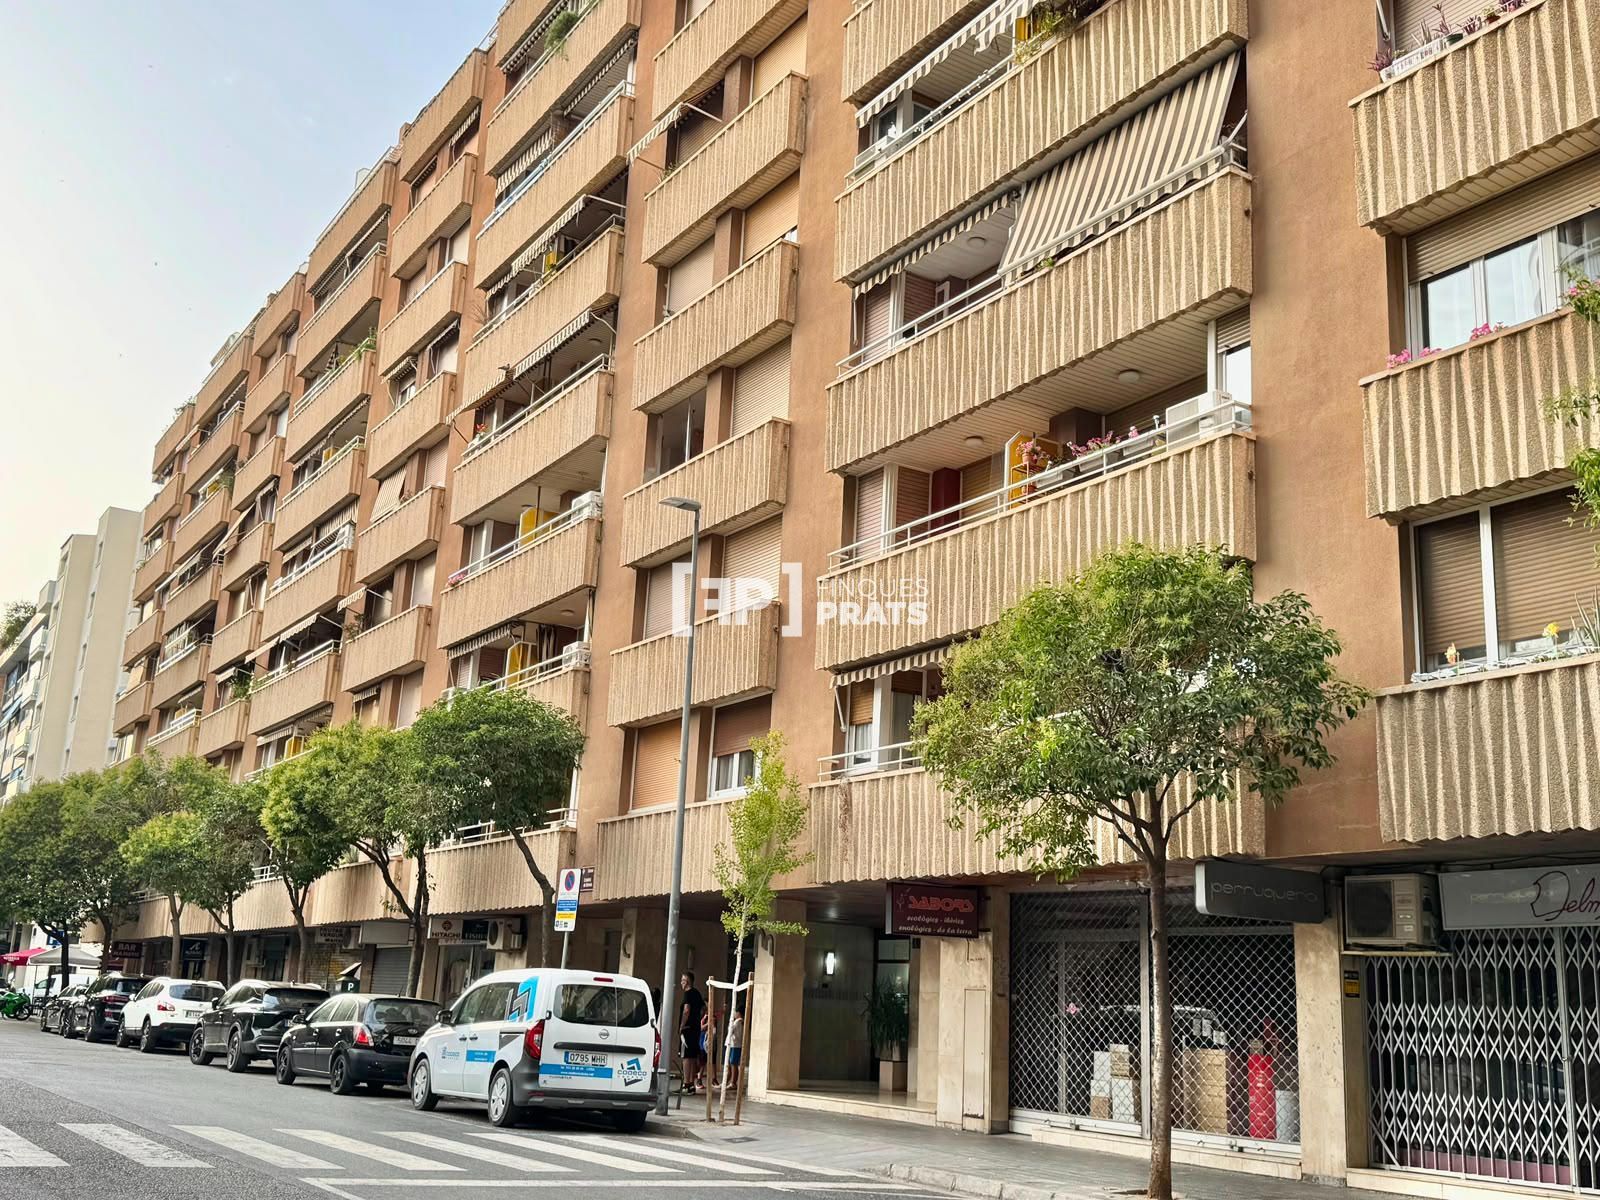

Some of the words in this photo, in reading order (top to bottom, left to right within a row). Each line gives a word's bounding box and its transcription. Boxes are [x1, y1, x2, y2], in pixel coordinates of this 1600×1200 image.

[1531, 871, 1600, 921] Delm
[118, 943, 136, 951] BAR
[347, 982, 354, 991] P
[570, 1053, 589, 1063] 0795
